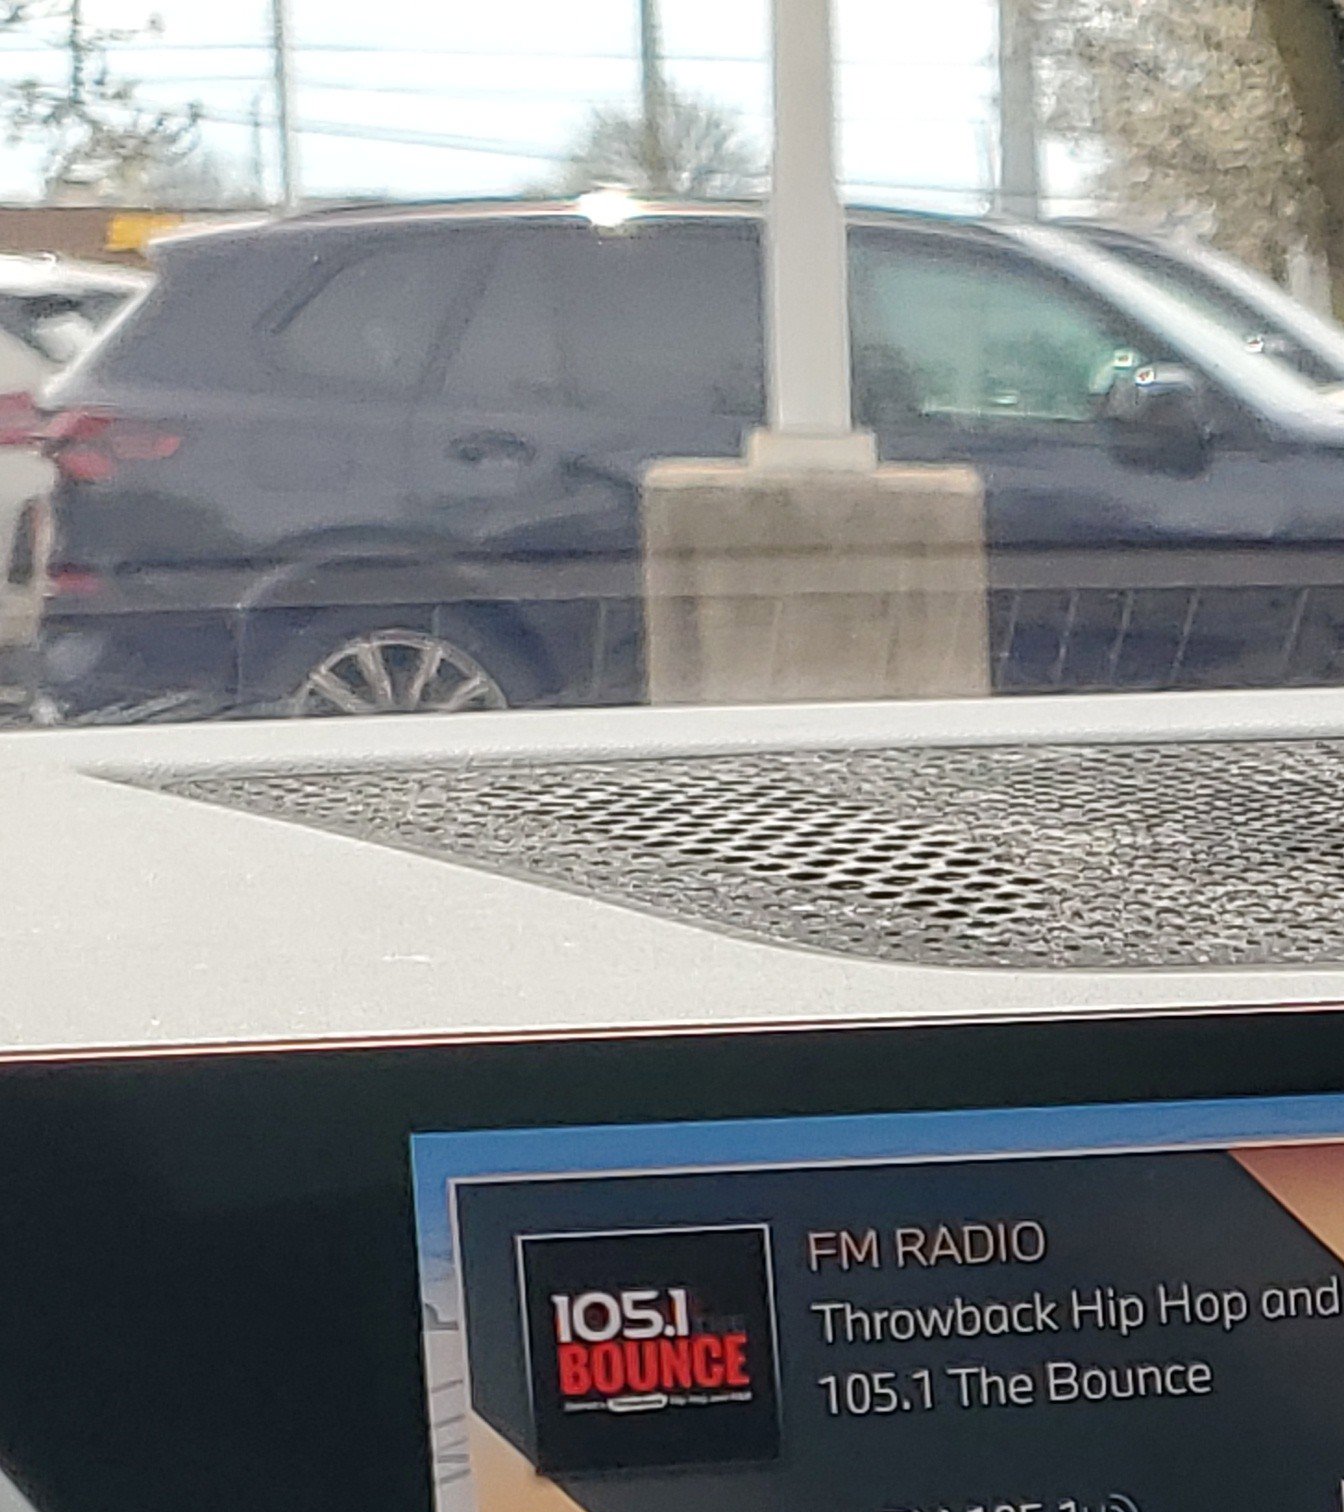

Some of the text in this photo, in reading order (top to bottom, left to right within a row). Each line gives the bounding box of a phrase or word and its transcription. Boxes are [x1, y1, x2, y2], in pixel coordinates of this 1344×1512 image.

[807, 1219, 1046, 1272] FM RADIO
[551, 1287, 690, 1344] 105.1
[810, 1290, 1060, 1344] Throwback
[1071, 1286, 1145, 1336] Hip
[1157, 1281, 1248, 1331] Hop
[1261, 1274, 1340, 1320] and
[557, 1331, 750, 1396] BOUNCE
[817, 1360, 1212, 1415] 105.1 The Bounce
